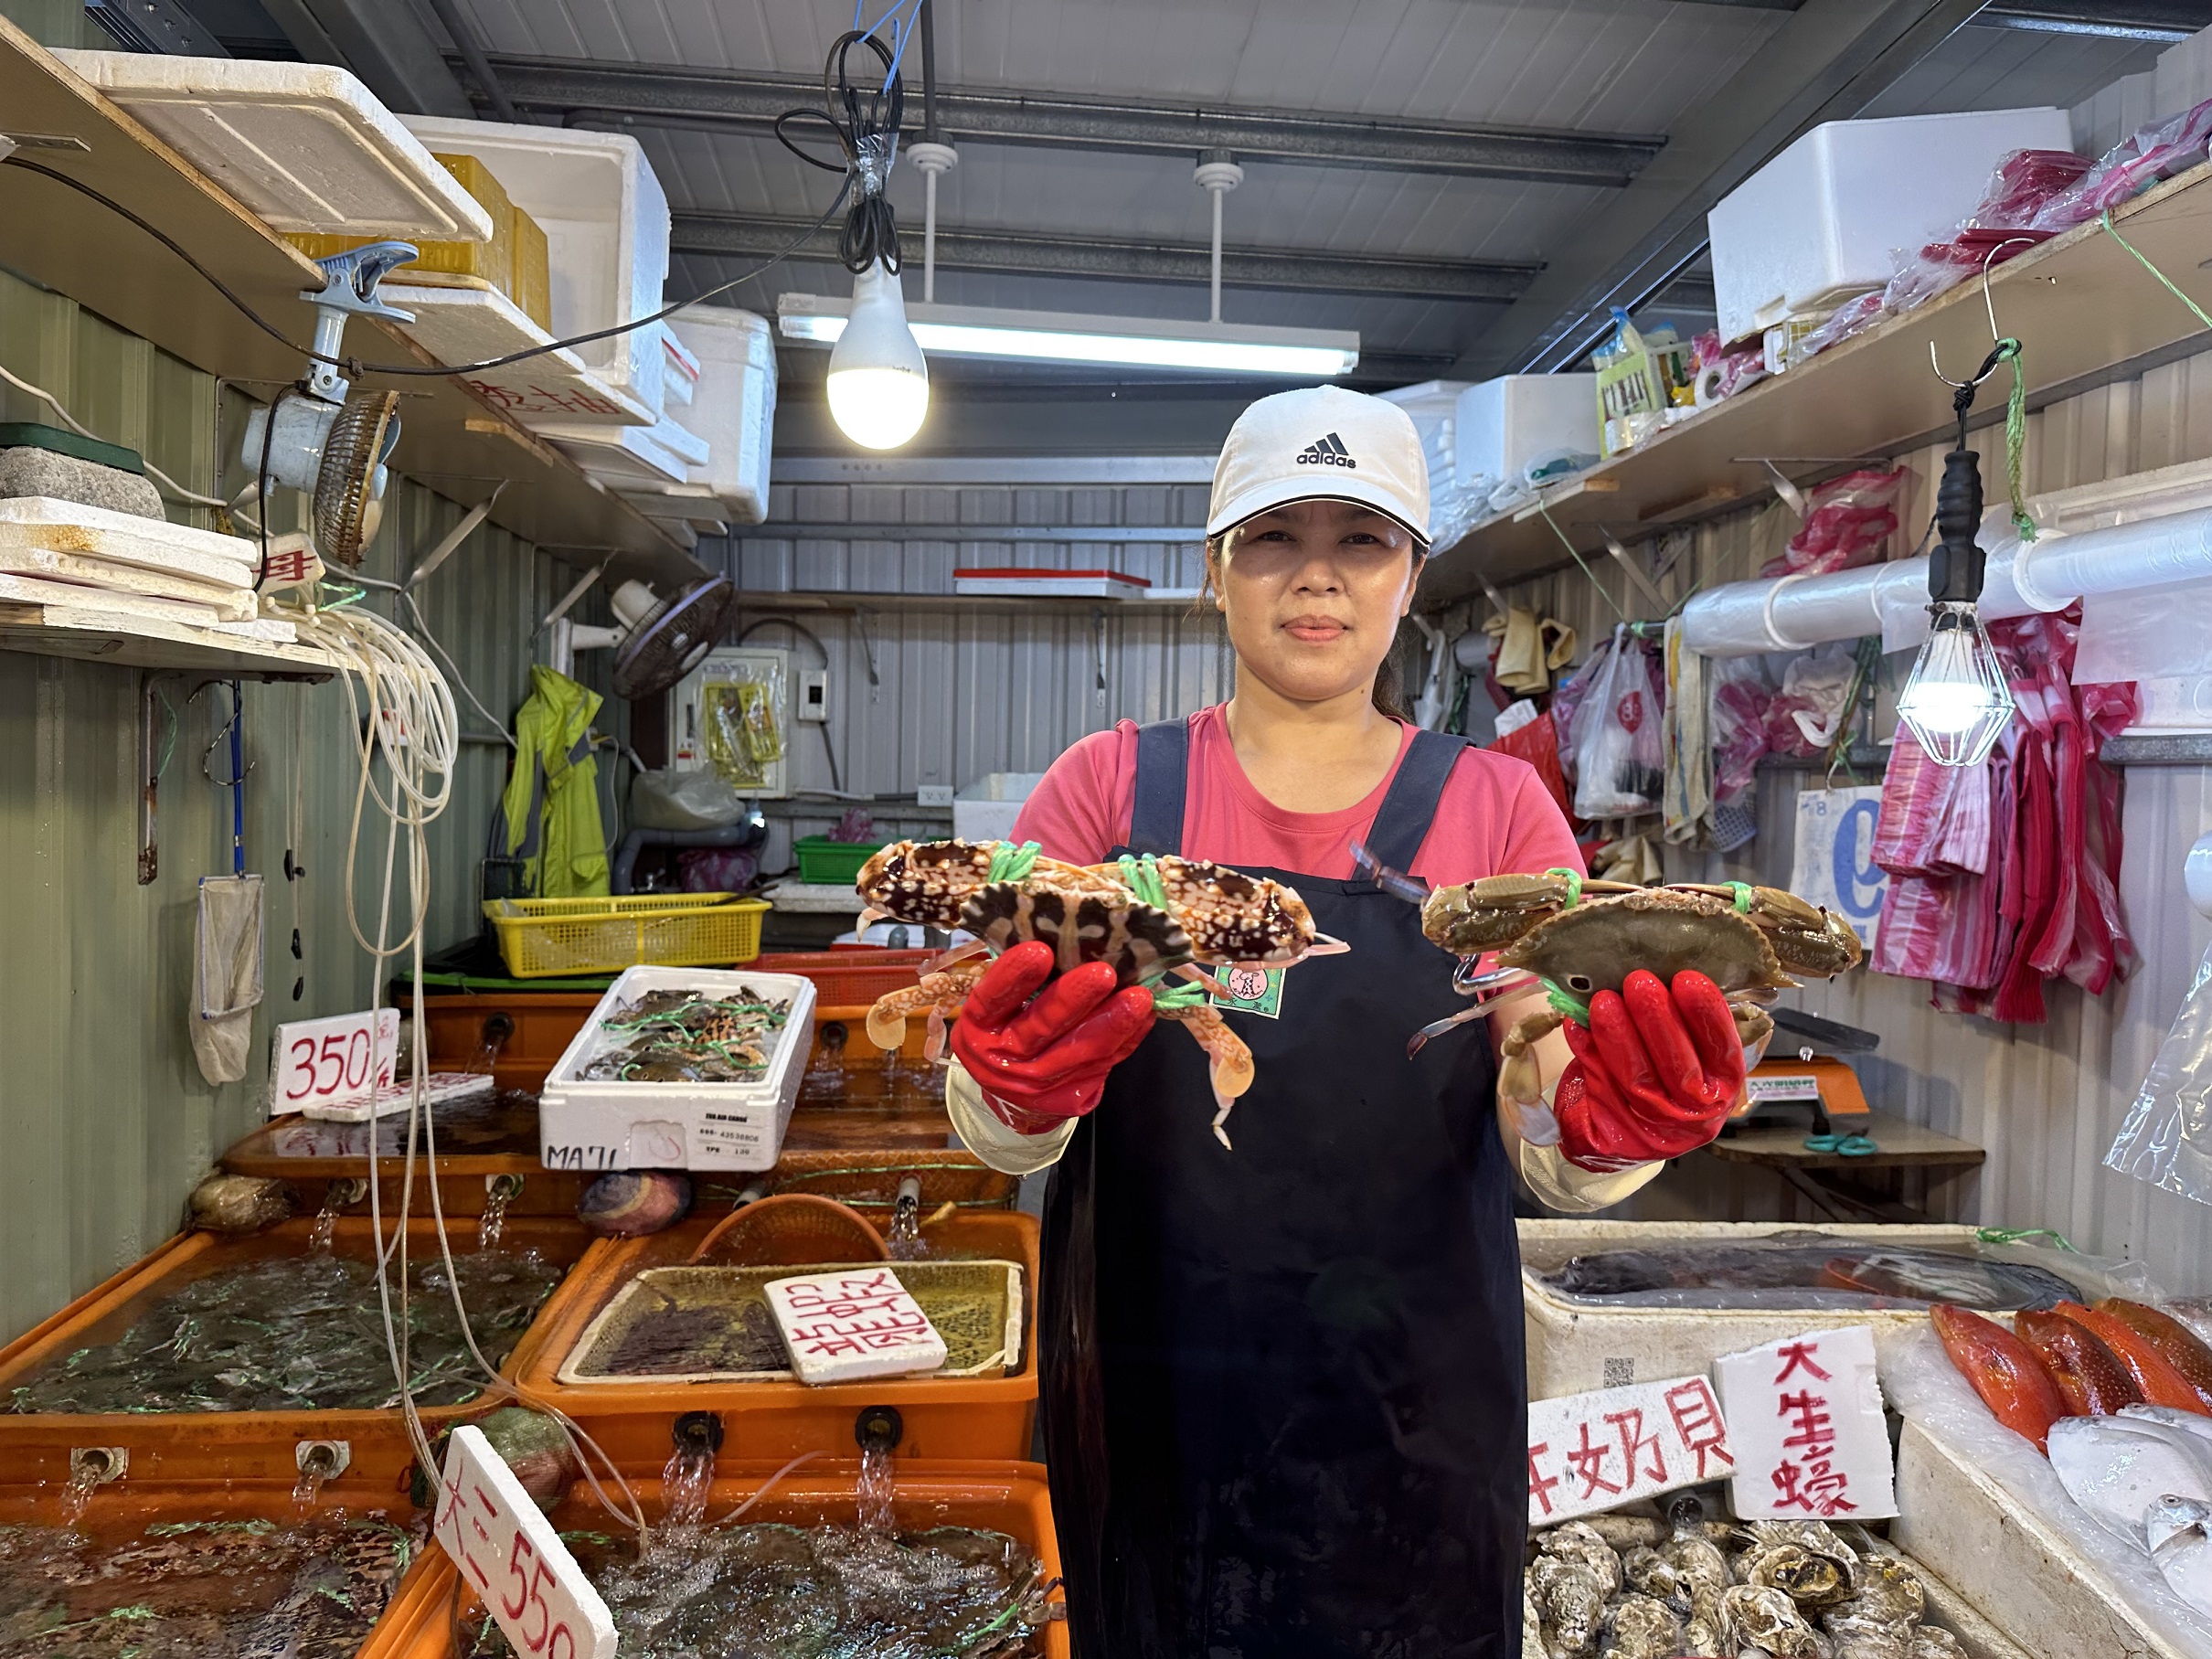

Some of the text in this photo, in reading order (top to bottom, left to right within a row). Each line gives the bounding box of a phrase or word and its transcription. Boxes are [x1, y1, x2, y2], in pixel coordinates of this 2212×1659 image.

[1296, 452, 1356, 469] adidas
[785, 1271, 933, 1356] 龍蝦
[1771, 1341, 1858, 1517] 大生蠔
